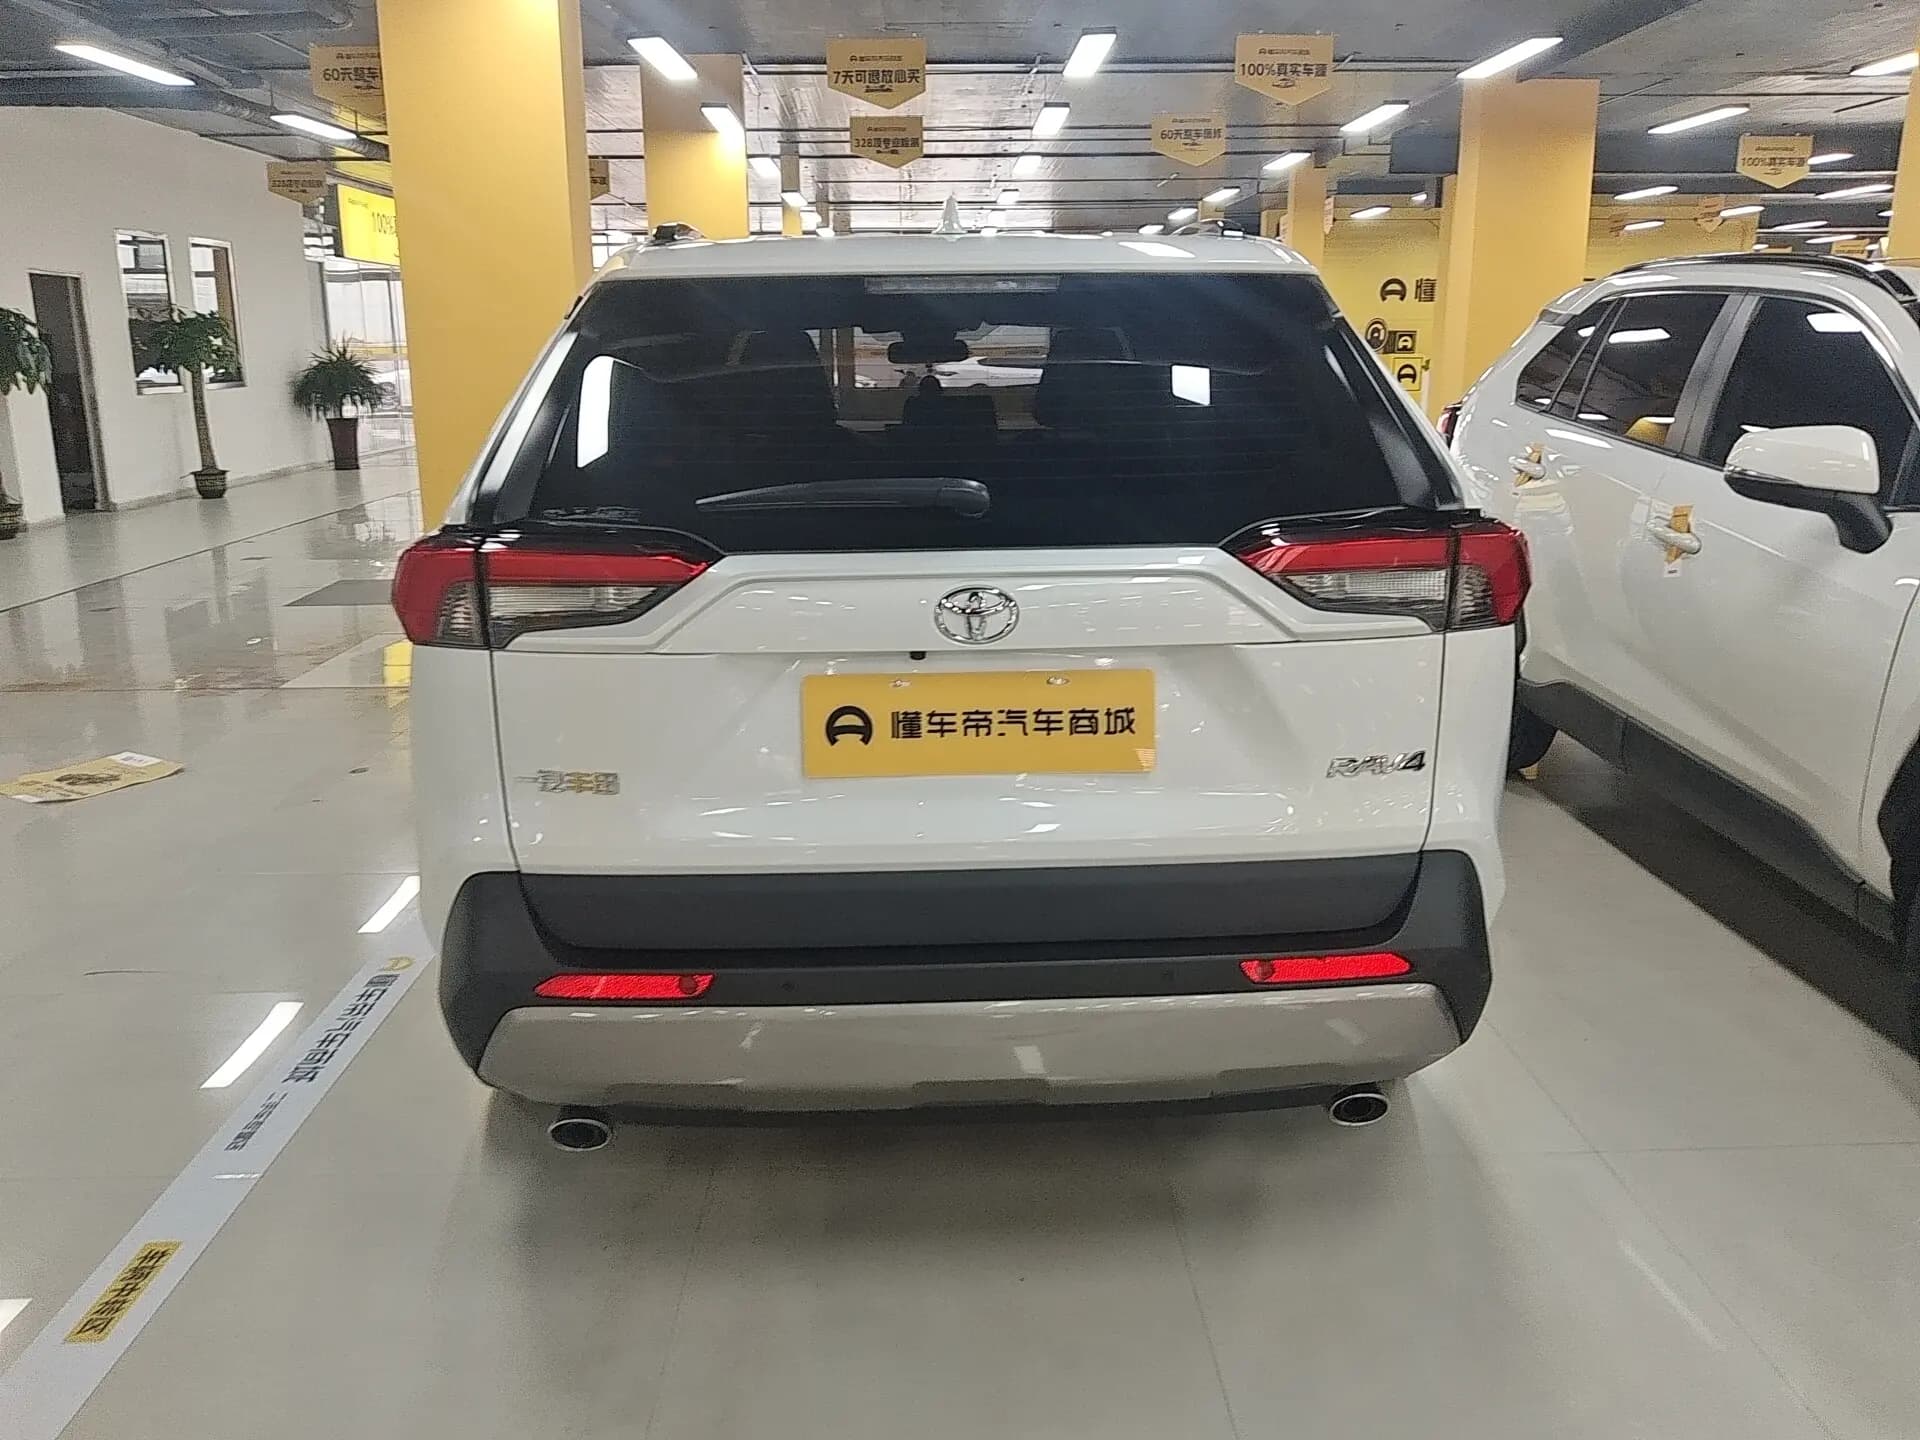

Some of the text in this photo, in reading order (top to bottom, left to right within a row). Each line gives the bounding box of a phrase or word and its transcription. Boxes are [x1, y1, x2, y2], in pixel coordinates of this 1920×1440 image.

[833, 68, 920, 84] 7天可退放心买
[1240, 63, 1328, 78] 100%真实车源
[891, 706, 1136, 740] 懂车帝汽车商城
[281, 973, 401, 1084] 懂车帝汽车商城
